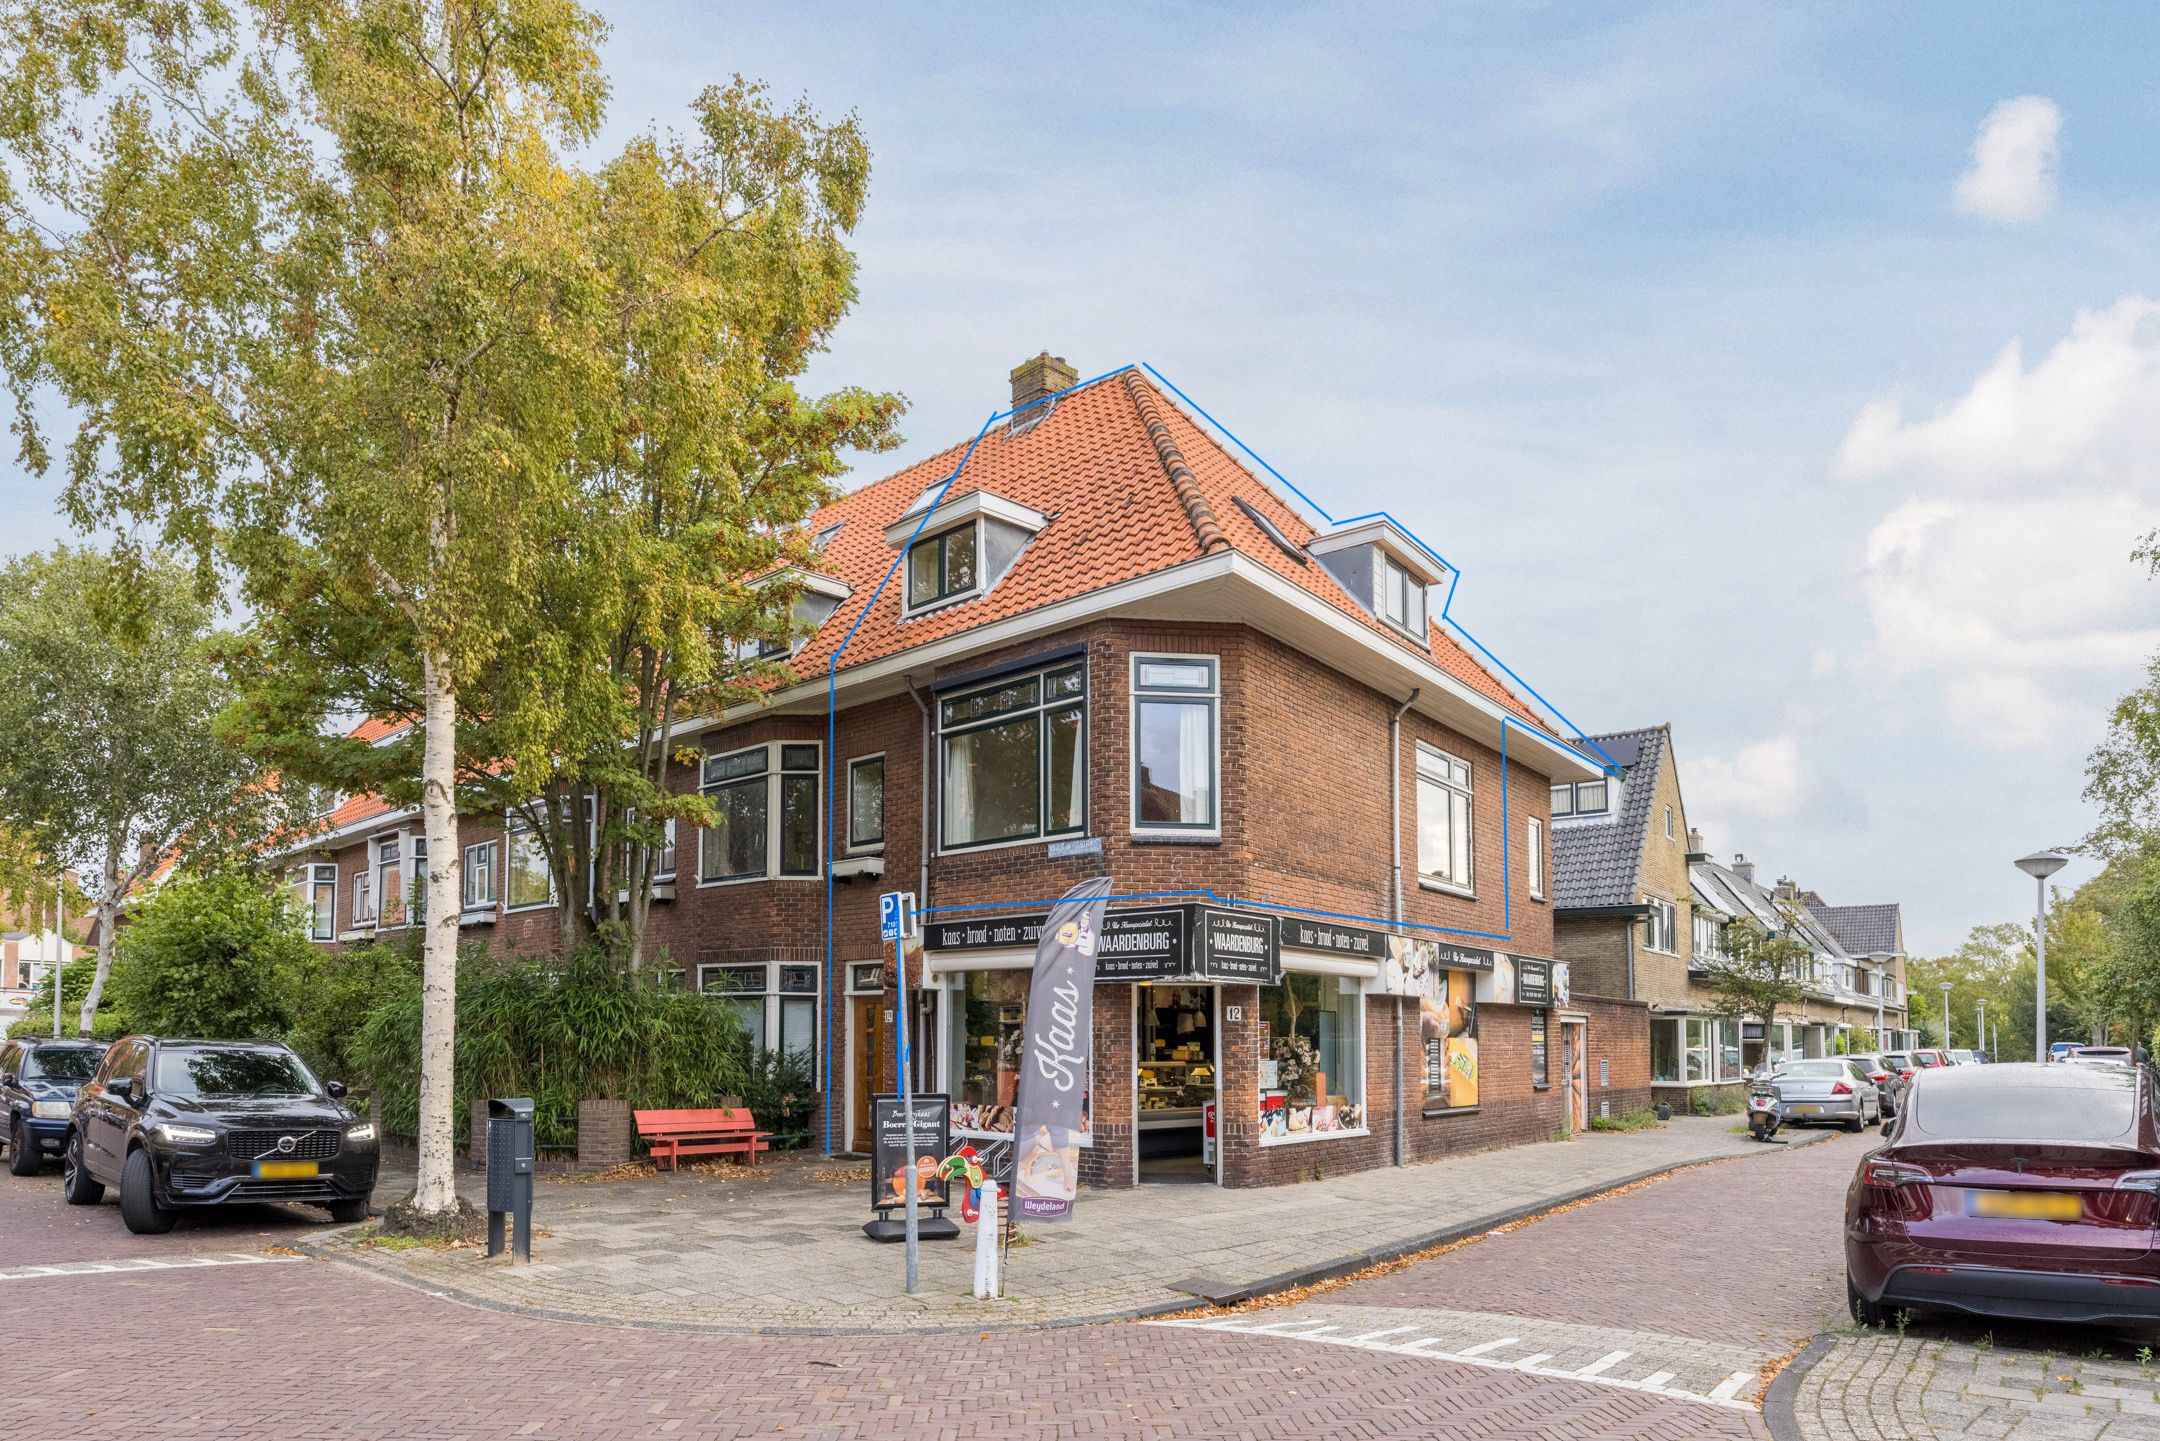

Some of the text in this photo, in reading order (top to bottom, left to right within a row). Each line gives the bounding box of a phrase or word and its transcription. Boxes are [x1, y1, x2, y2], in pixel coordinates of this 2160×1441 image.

[882, 897, 894, 924] P
[942, 920, 1045, 946] kaas brood noten zuiv
[1098, 931, 1170, 953] WAARDENBURG
[1214, 932, 1264, 954] WAARDENBURG
[1300, 924, 1314, 945] kaas
[1318, 927, 1332, 947] brood
[1354, 933, 1369, 951] zuivel
[1229, 1007, 1239, 1020] 12
[1034, 980, 1084, 1092] Kaas
[882, 1120, 941, 1129] Boere Gigant
[1024, 1201, 1065, 1212] Weydeland
